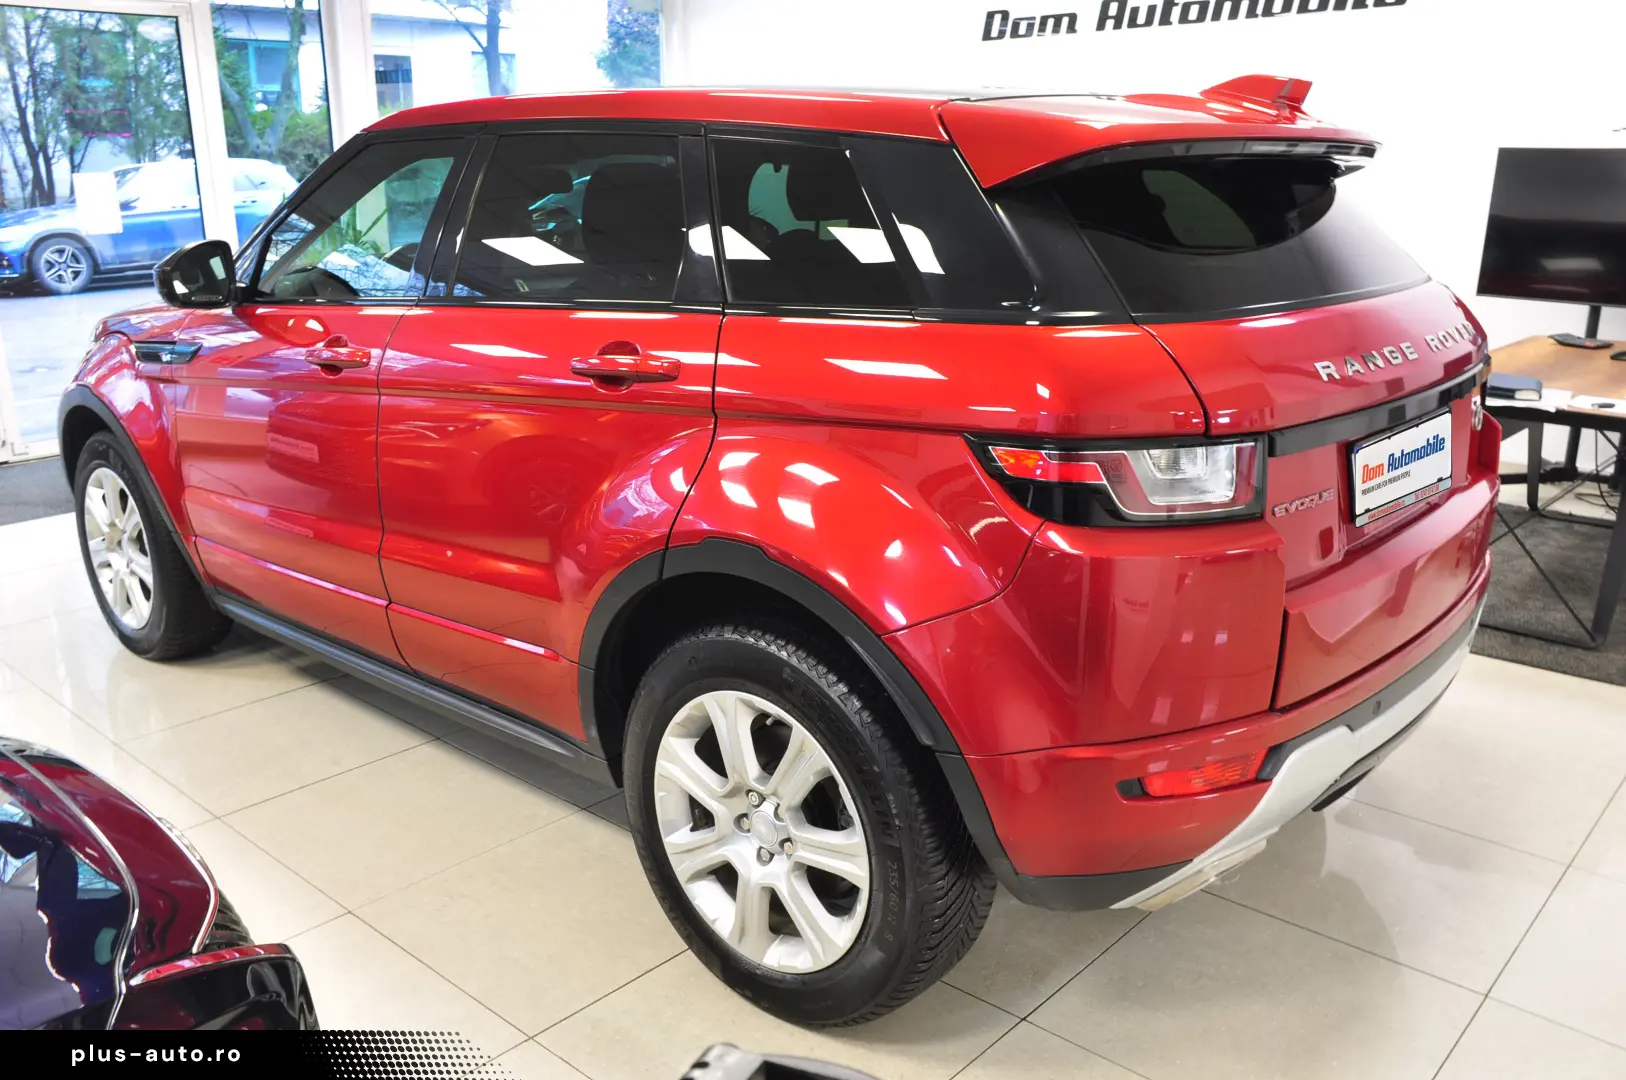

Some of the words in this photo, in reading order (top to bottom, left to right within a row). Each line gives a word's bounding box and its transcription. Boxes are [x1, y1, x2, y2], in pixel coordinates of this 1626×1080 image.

[982, 10, 1078, 41] Dom
[1095, 0, 1407, 32] Automo
[1314, 341, 1419, 382] RANGE
[1424, 320, 1476, 353] ROVER
[1361, 463, 1385, 484] Dom
[1387, 433, 1446, 474] Automobile
[1273, 488, 1335, 518] EVOQUE
